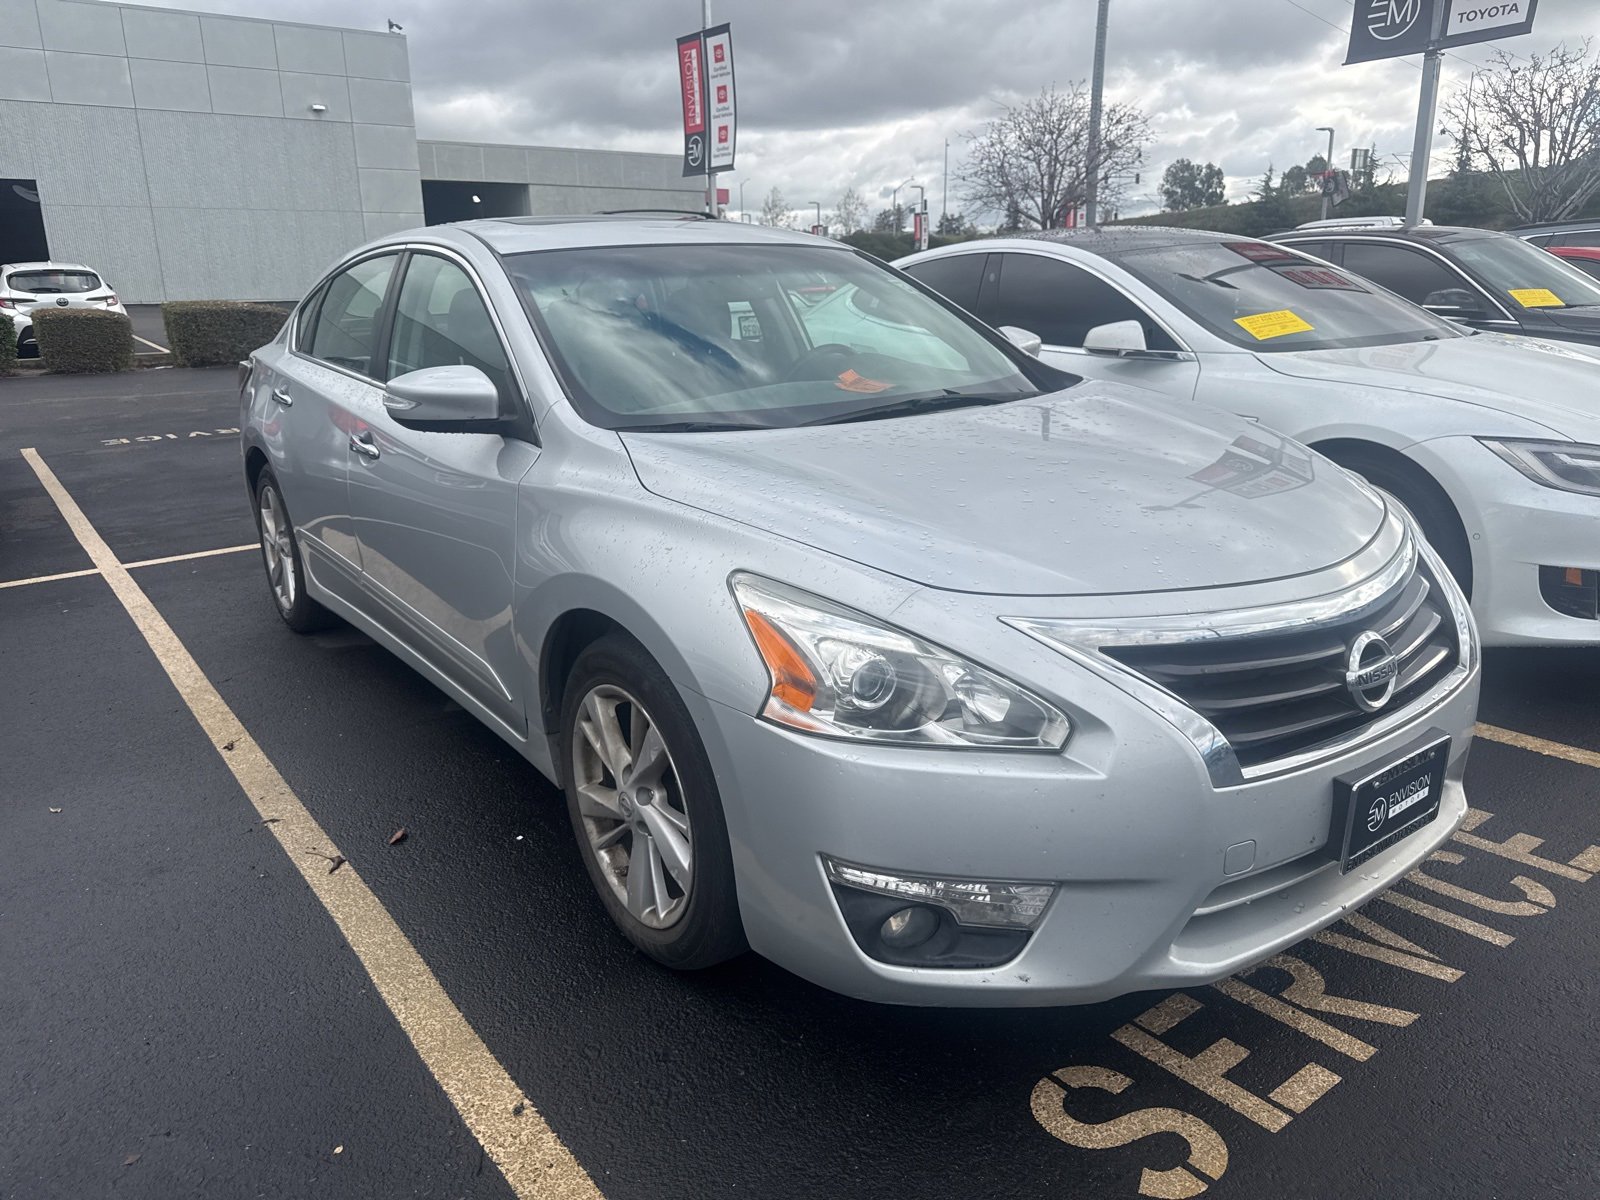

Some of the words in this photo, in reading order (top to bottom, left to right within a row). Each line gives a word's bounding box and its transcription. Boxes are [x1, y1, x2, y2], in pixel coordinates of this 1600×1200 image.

[1457, 2, 1519, 23] TOYOTA
[684, 49, 697, 127] ENVISION
[1356, 661, 1397, 687] NISSAN
[1389, 772, 1431, 808] ENVISION
[1390, 790, 1427, 815] MOTORS
[1030, 808, 1600, 1199] SERVICE
